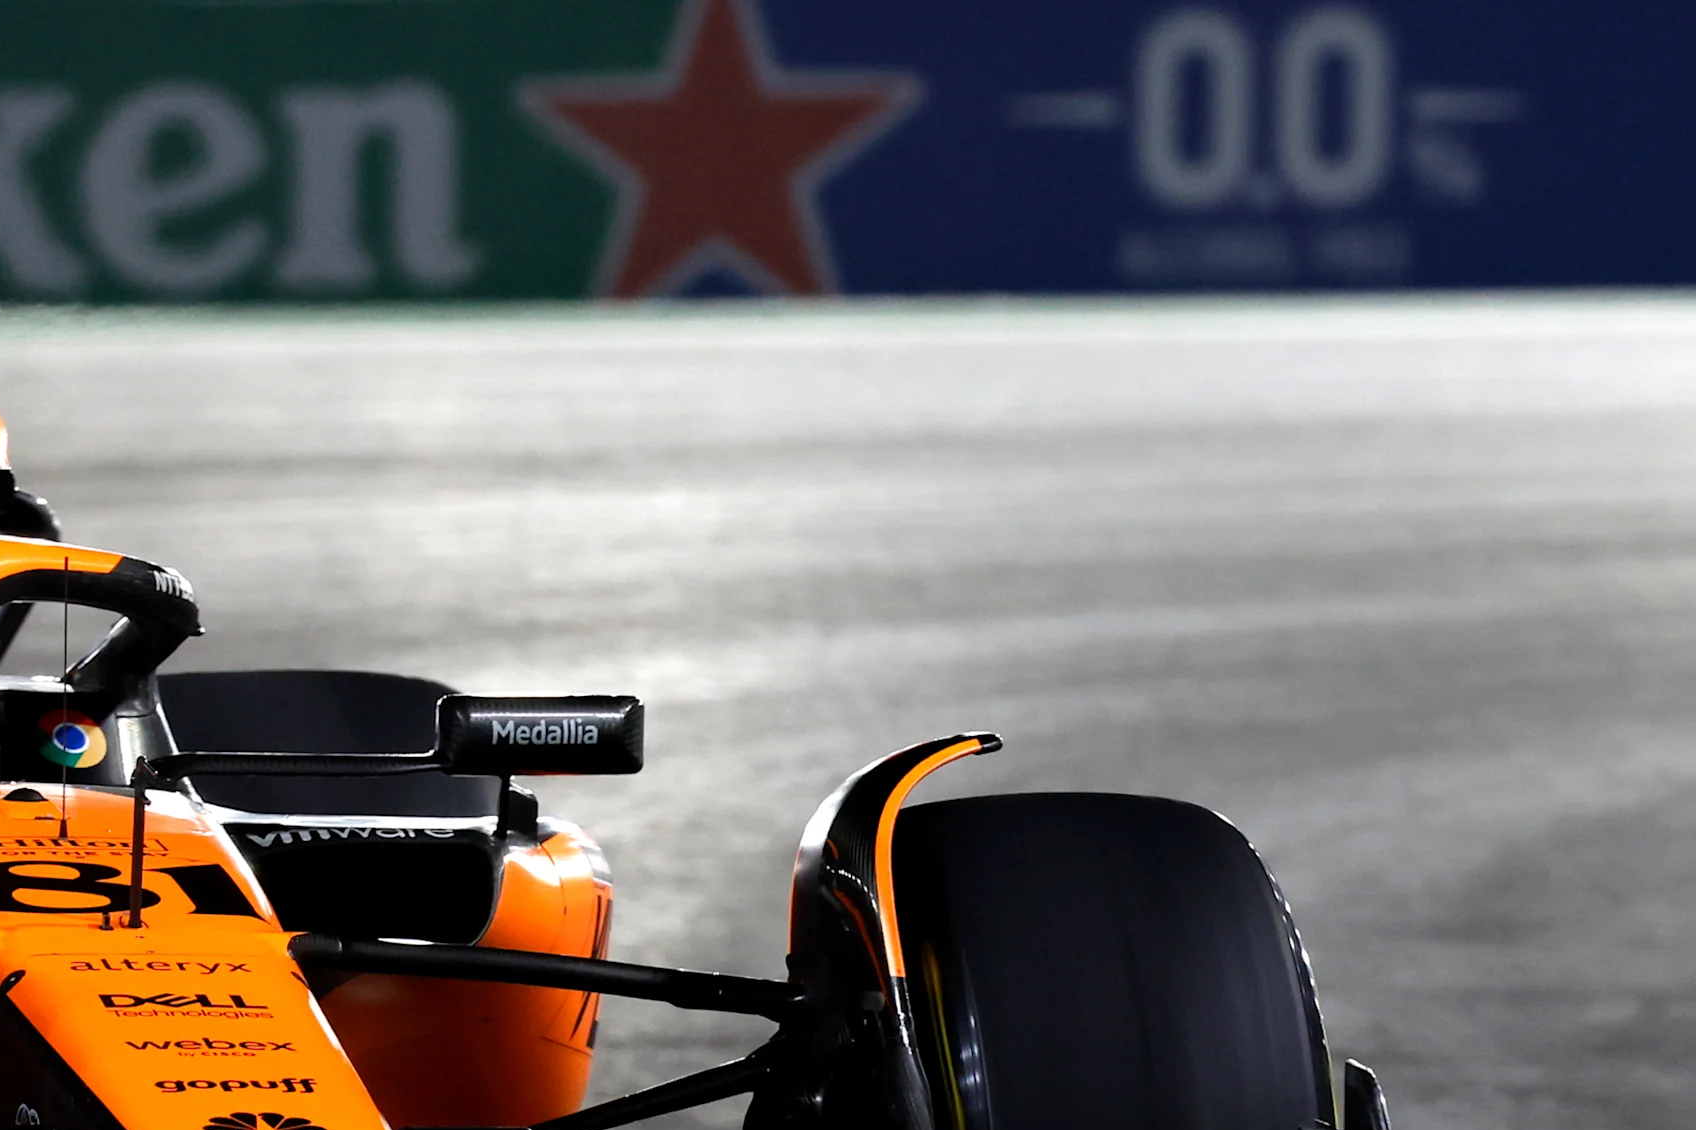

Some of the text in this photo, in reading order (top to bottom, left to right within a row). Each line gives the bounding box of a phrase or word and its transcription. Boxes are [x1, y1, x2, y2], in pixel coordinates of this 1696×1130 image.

[491, 718, 599, 745] Medallia
[69, 958, 252, 974] alteryx
[98, 993, 269, 1009] DELL
[112, 1009, 275, 1019] Technologies
[124, 1037, 297, 1052] webex
[154, 1078, 317, 1093] gopuff
